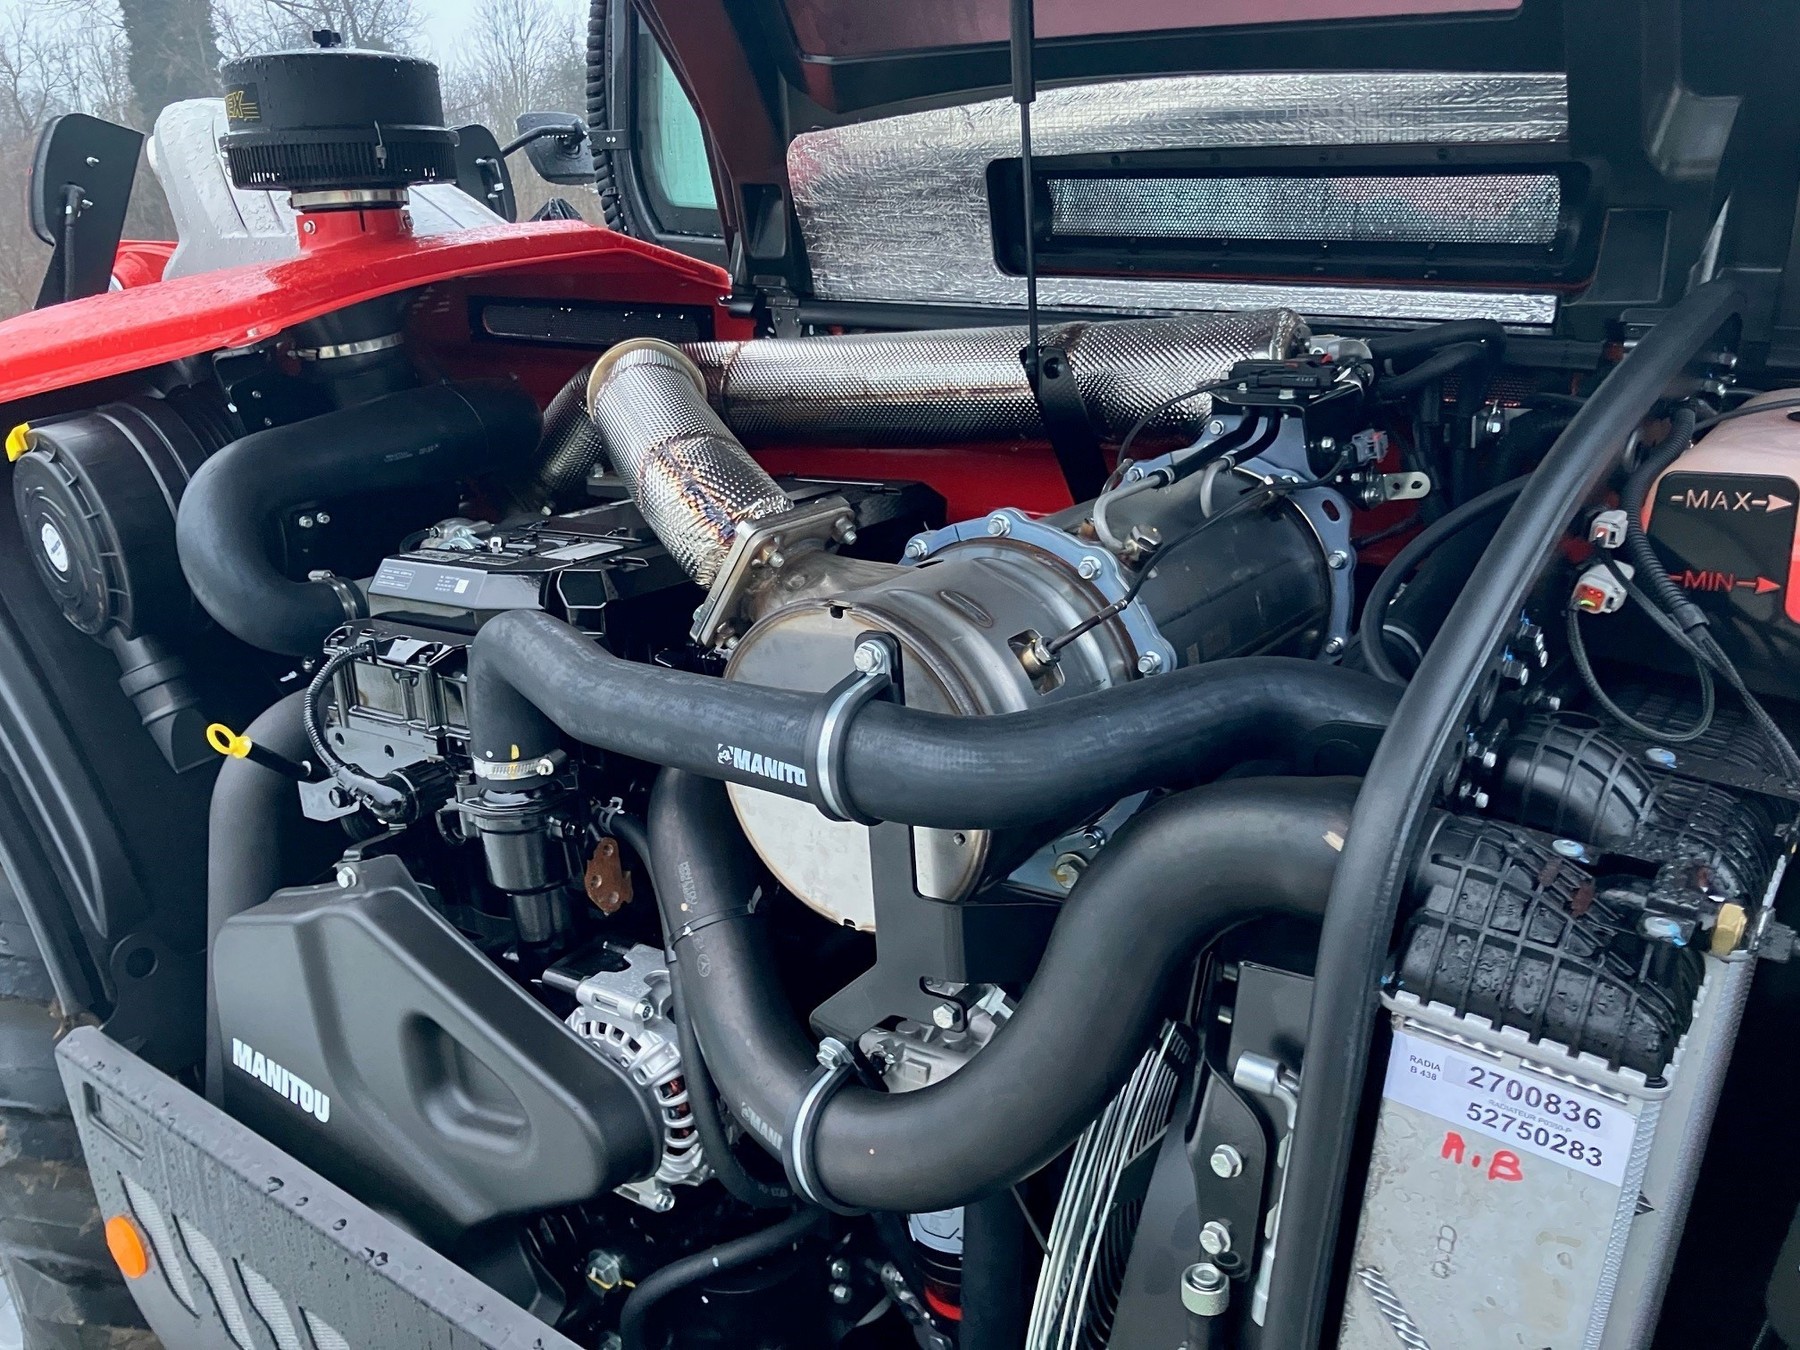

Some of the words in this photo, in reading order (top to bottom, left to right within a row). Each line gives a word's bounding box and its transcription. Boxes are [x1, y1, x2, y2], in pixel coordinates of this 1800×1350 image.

[1685, 489, 1751, 511] MAX
[1683, 570, 1734, 592] MIN
[1410, 1054, 1441, 1072] RADIA
[1410, 1065, 1418, 1074] B
[232, 1037, 330, 1123] MANITOU
[1467, 1066, 1603, 1130] 2700836
[1466, 1102, 1603, 1168] 52750283
